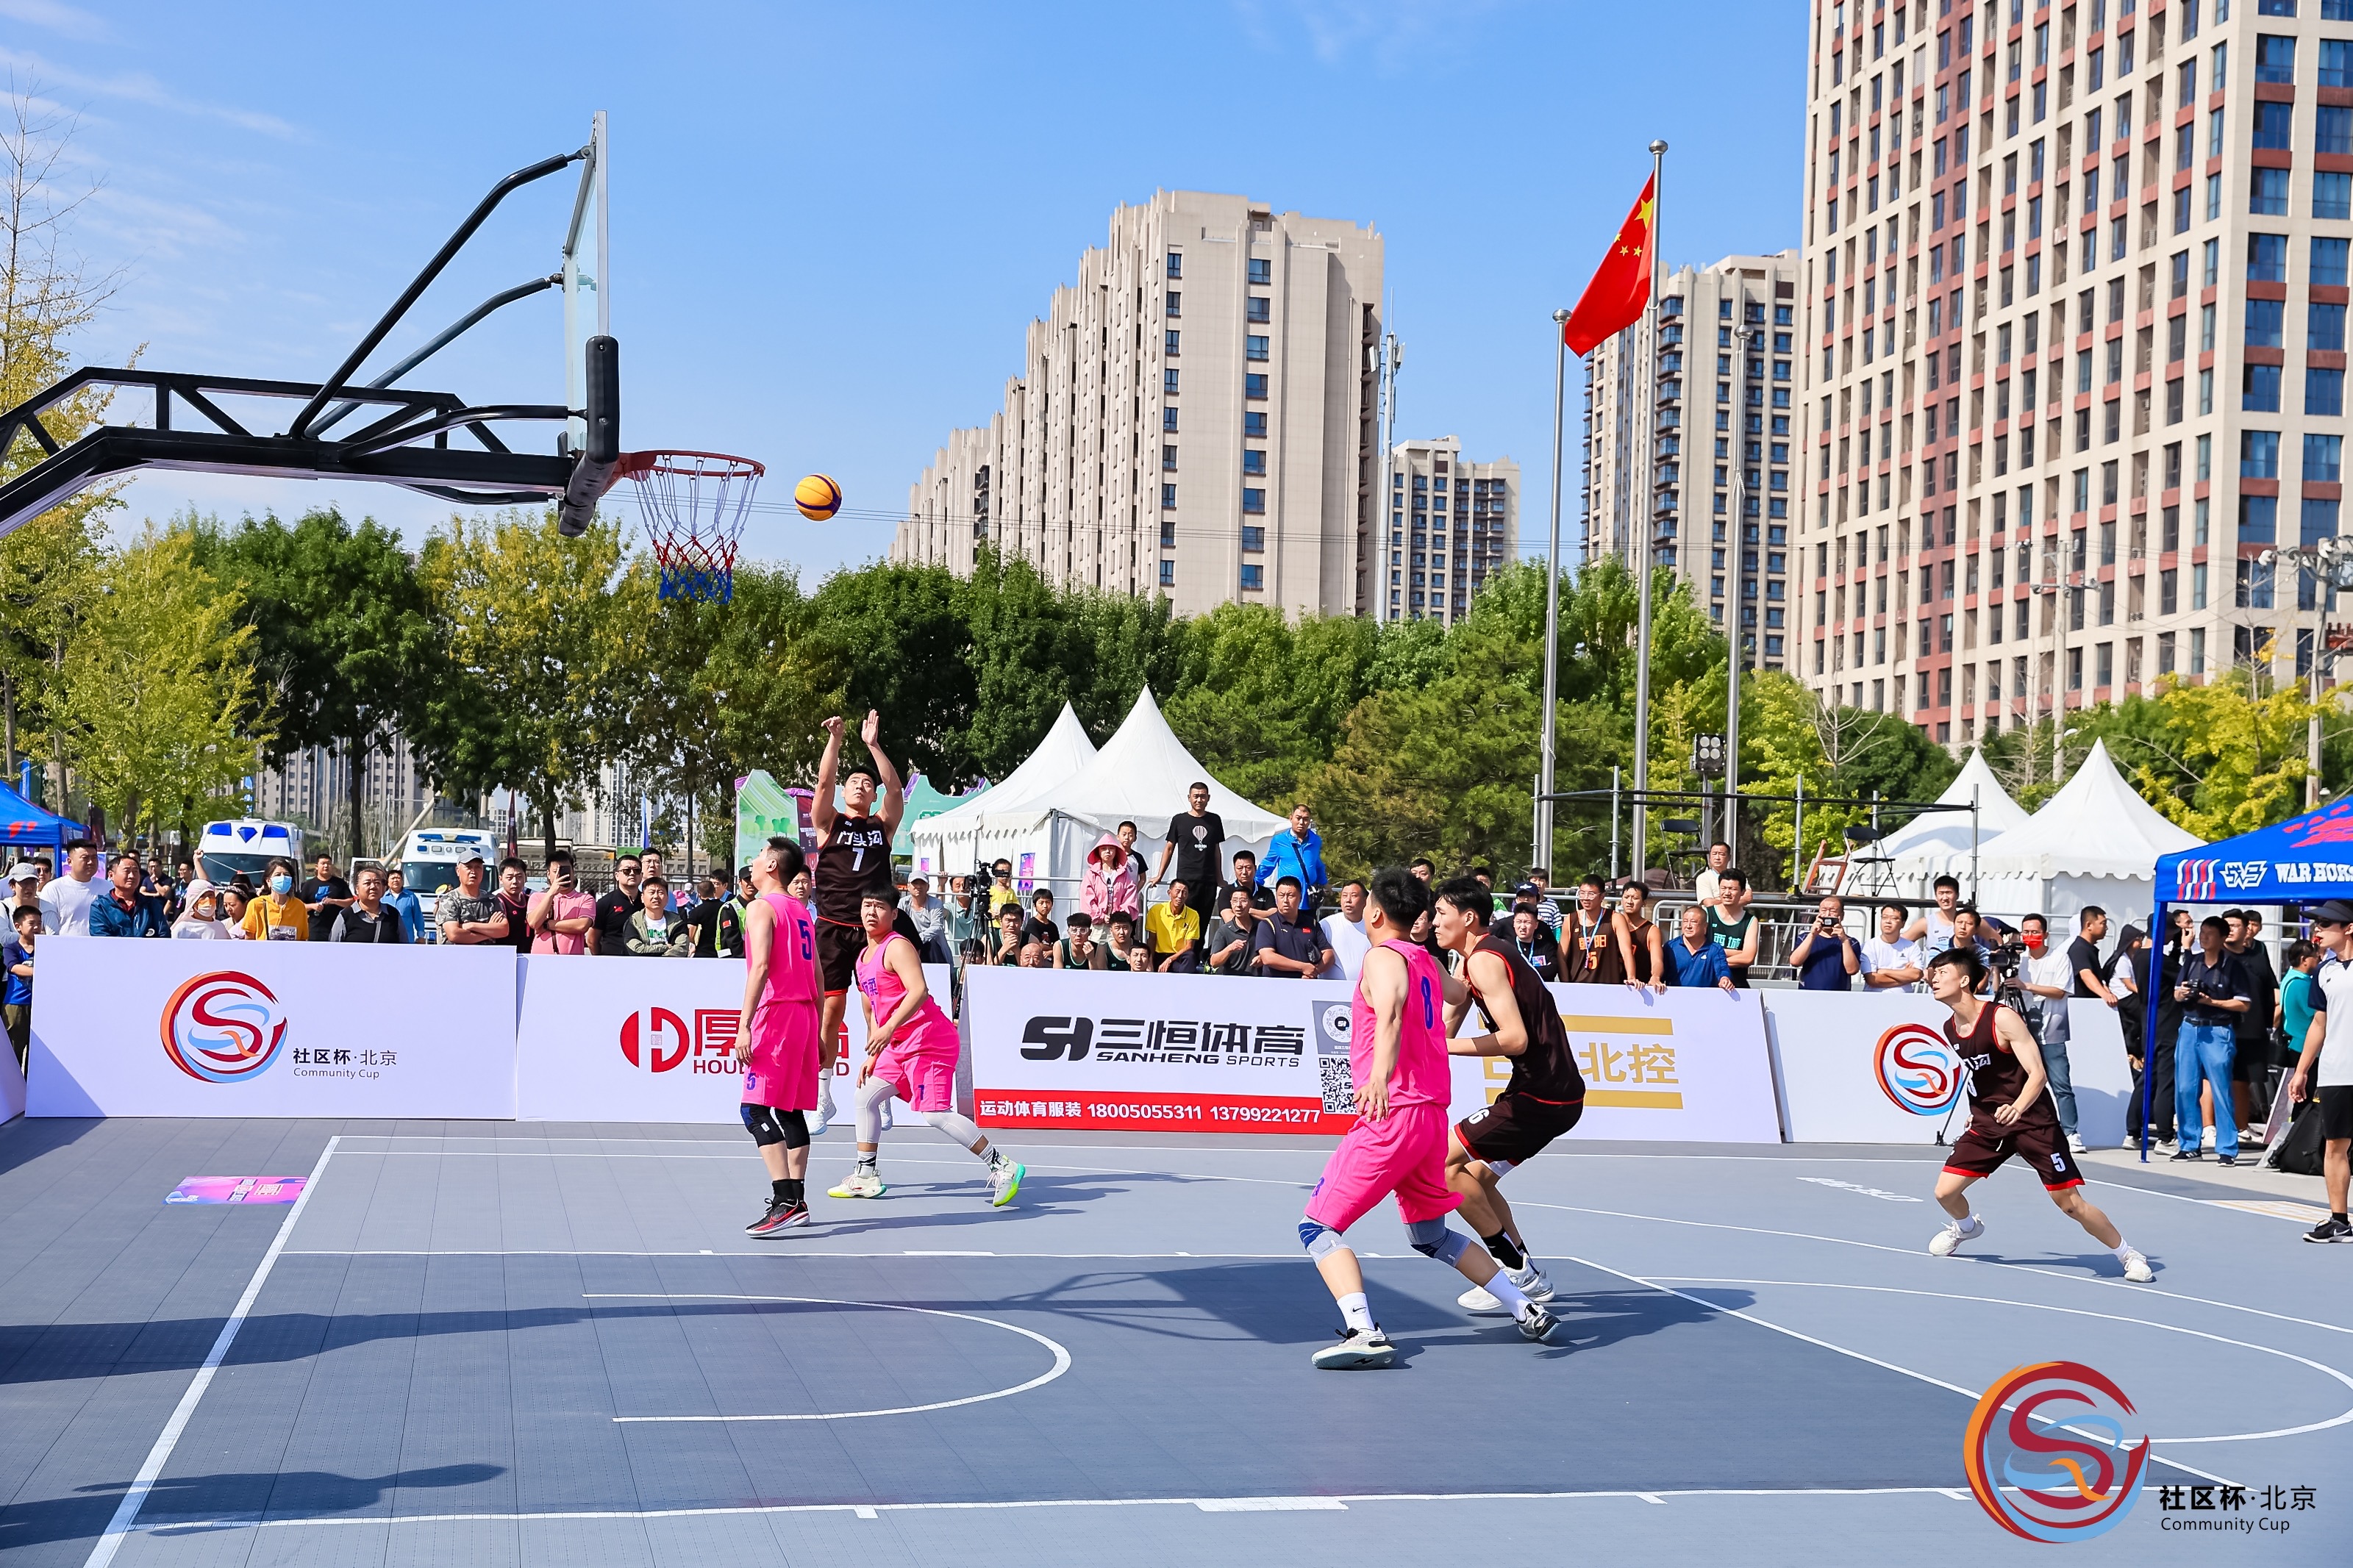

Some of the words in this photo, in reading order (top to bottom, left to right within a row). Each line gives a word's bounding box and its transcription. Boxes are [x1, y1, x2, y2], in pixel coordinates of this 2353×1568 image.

[837, 830, 883, 847] 门头沟
[852, 847, 865, 872] 7
[2275, 862, 2312, 884] WAR
[796, 919, 813, 961] 5
[1713, 933, 1742, 949] 西城
[1421, 975, 1434, 1030] 8
[1096, 1018, 1305, 1055] 三恒体育
[293, 1048, 398, 1066] 社区杯·北京
[1096, 1051, 1220, 1064] SANHENG
[1226, 1056, 1300, 1067] SPORTS
[293, 1067, 357, 1080] Community
[358, 1069, 380, 1081] Cup
[746, 1073, 756, 1091] 5
[979, 1100, 1082, 1118] 运动体育服装
[1087, 1103, 1202, 1120] 18005055311
[1210, 1106, 1321, 1123] 13799221277
[1468, 1108, 1490, 1125] 6
[2050, 1152, 2066, 1173] 5
